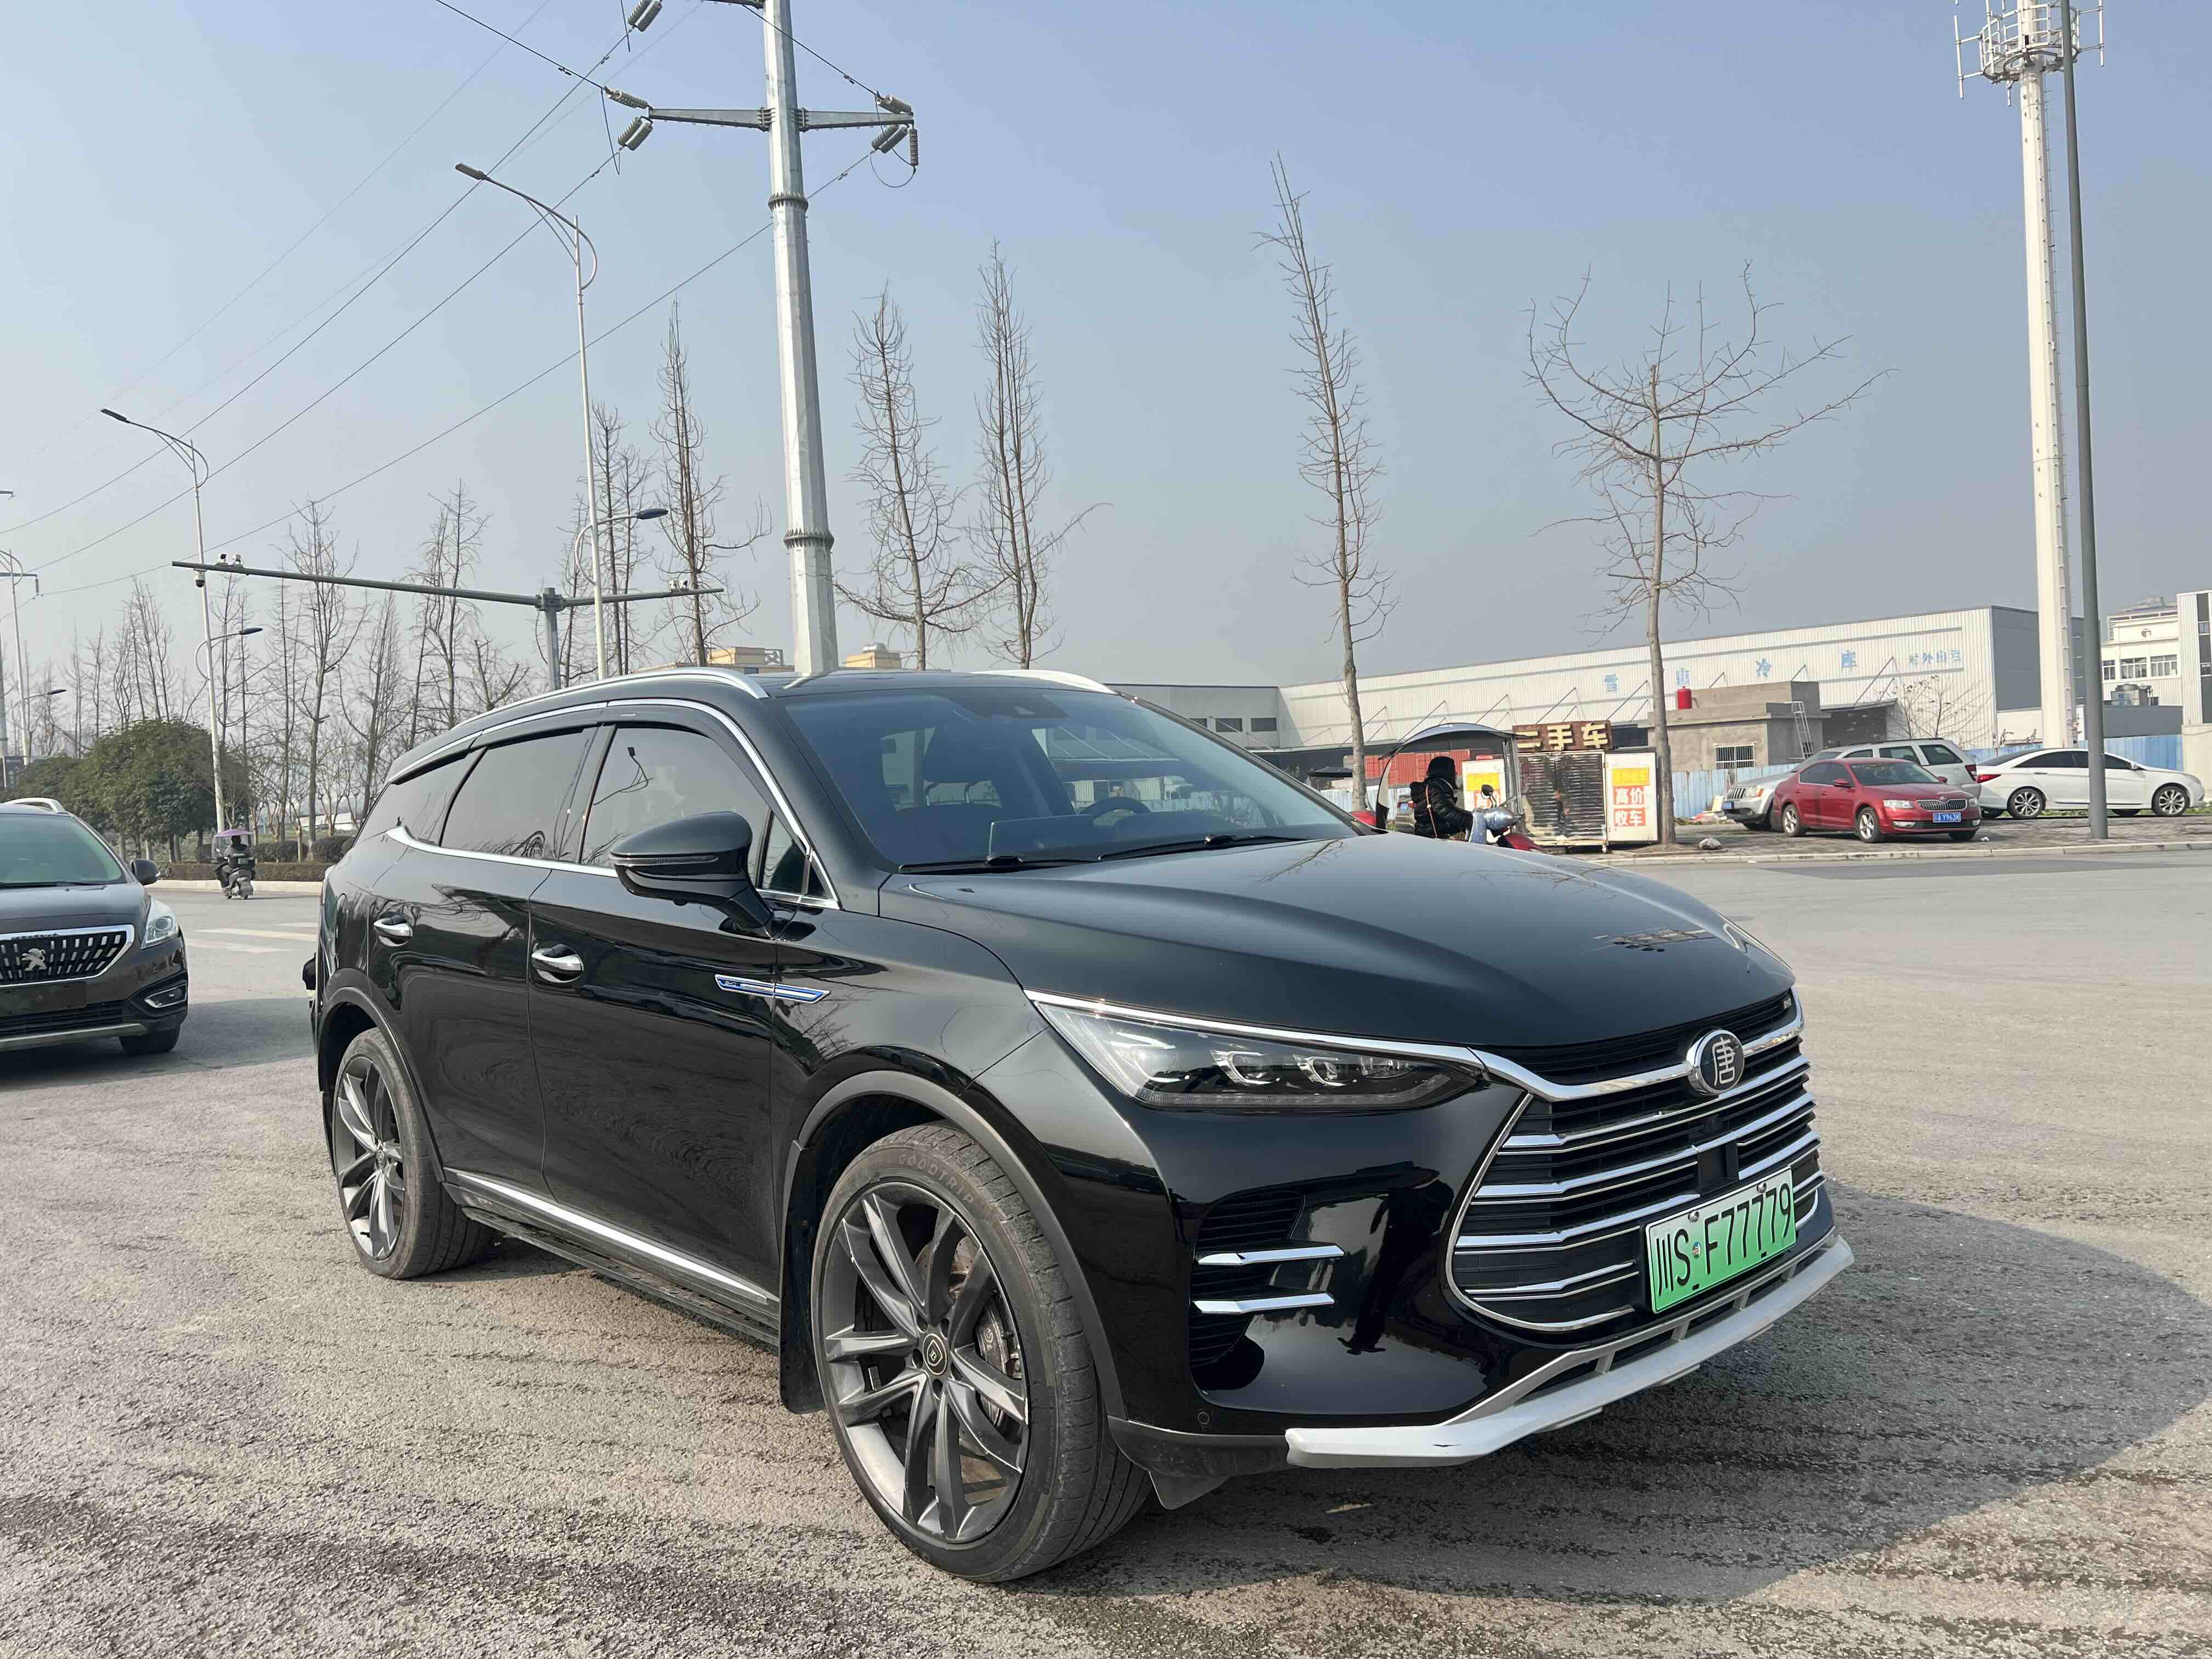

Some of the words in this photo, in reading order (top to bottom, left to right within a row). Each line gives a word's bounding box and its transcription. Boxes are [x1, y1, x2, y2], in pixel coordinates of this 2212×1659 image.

[1516, 723, 1609, 751] 二手车
[1615, 787, 1643, 804] 高价
[1615, 809, 1643, 826] 收车
